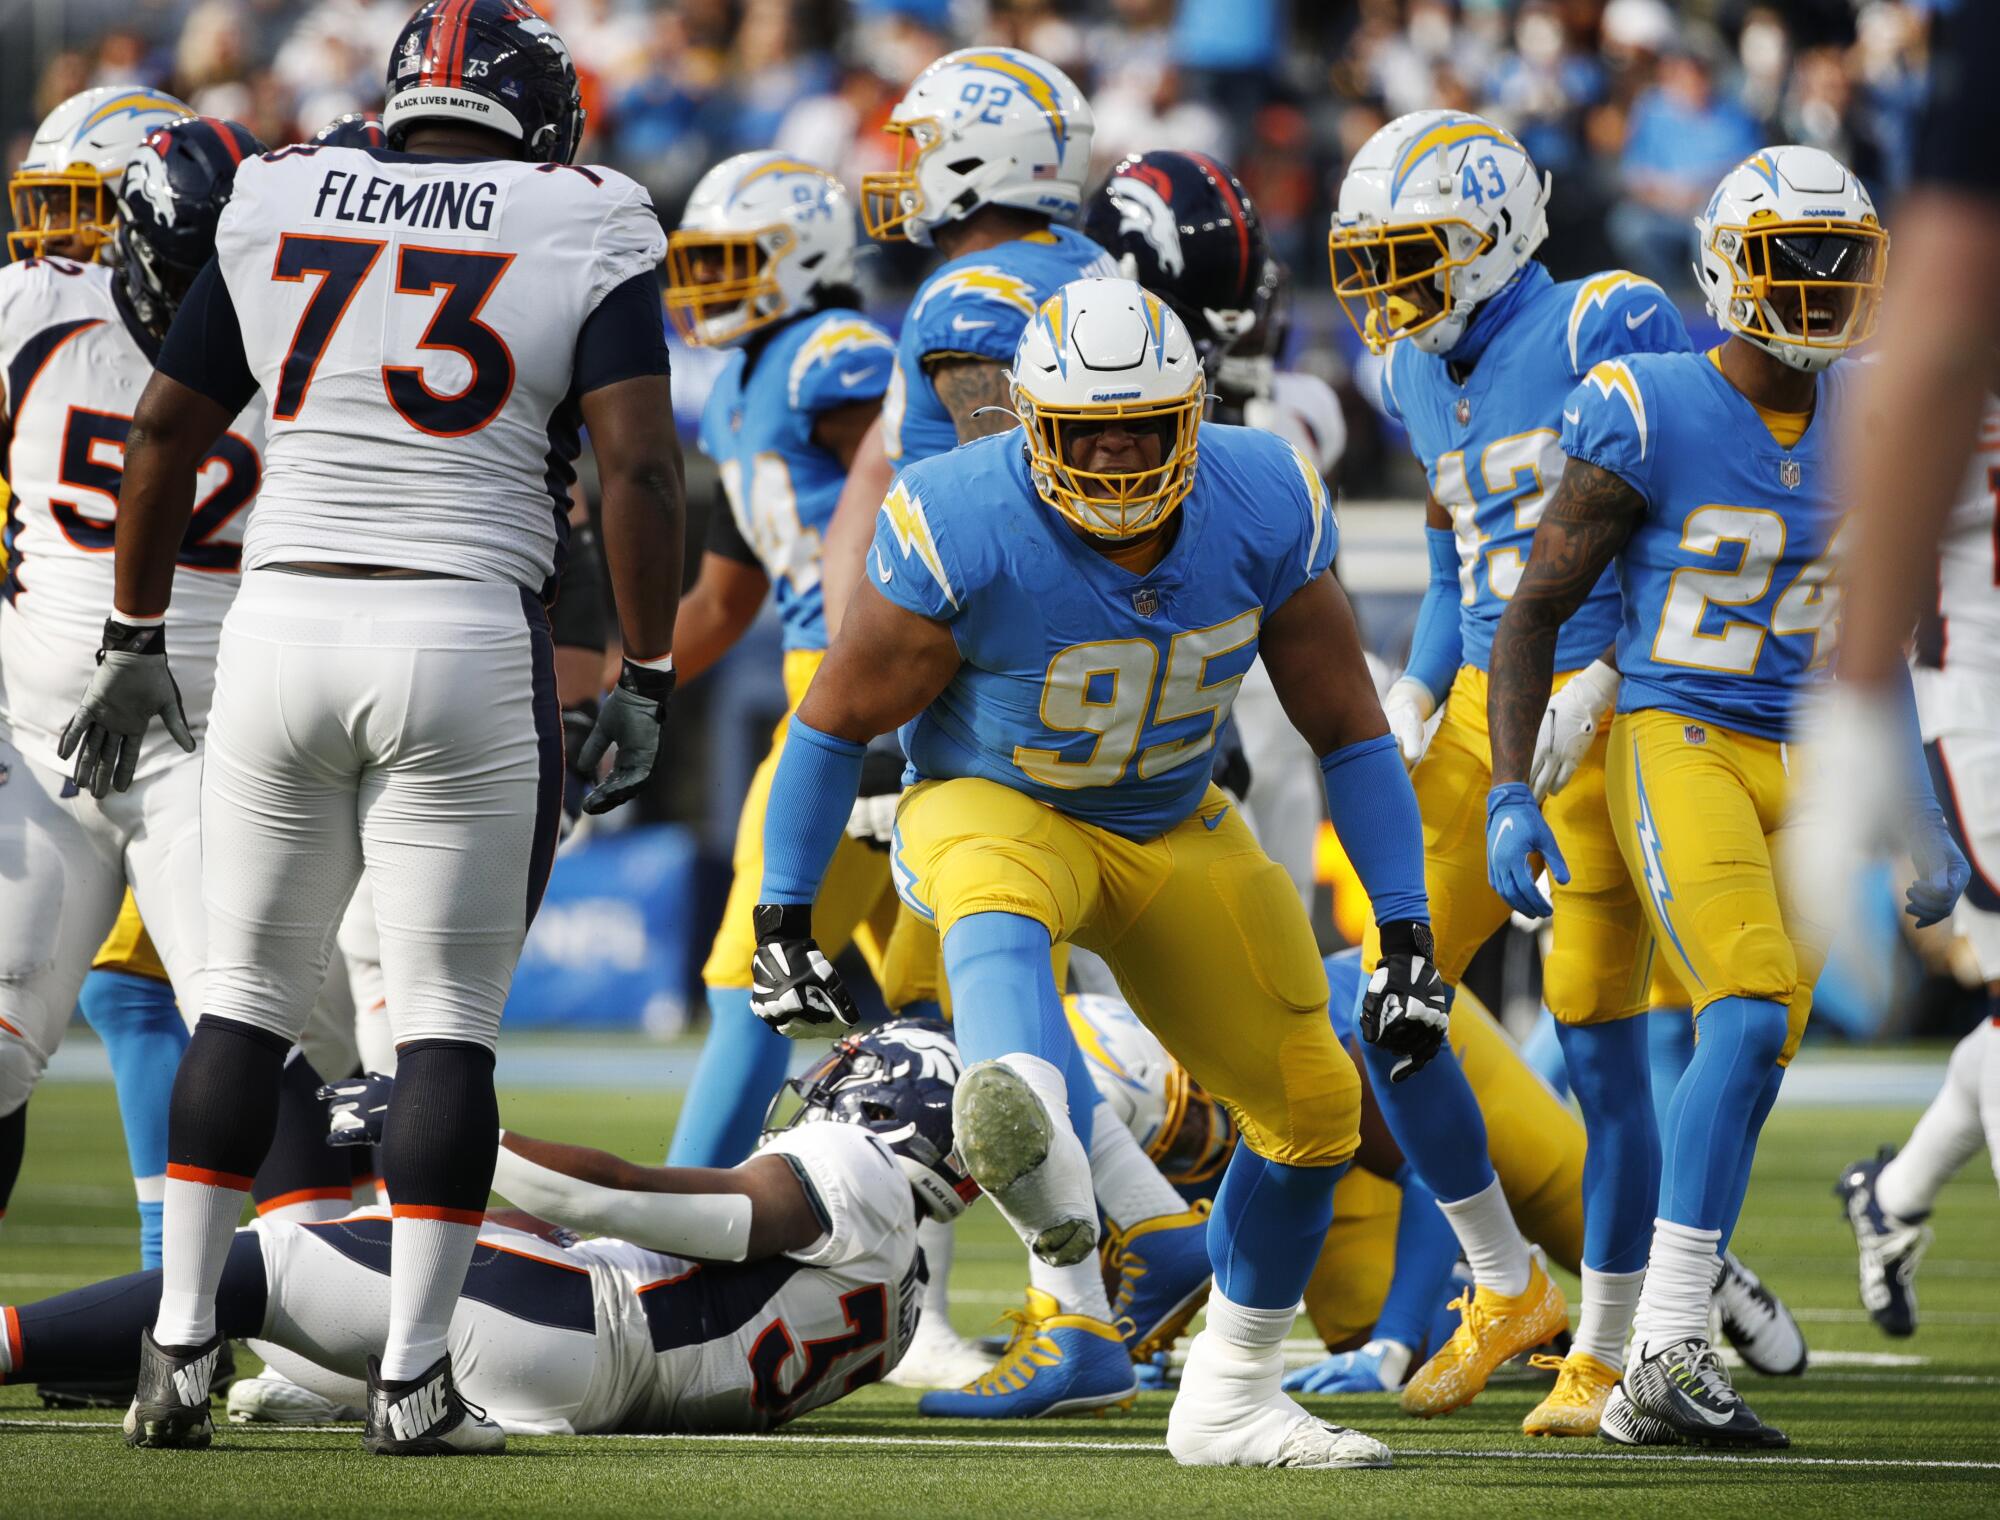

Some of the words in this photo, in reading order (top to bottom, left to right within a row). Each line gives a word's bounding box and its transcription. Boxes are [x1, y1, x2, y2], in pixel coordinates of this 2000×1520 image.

[465, 58, 489, 77] 73
[395, 97, 418, 110] BLACK
[420, 96, 447, 105] LIVES
[450, 97, 490, 113] MATTER
[954, 83, 1012, 124] 92
[313, 170, 497, 231] FLEMING
[1462, 154, 1506, 204] 43
[271, 232, 517, 438] 73
[1650, 503, 1864, 675] 24
[1013, 605, 1263, 790] 95
[387, 1373, 447, 1441] NIKE
